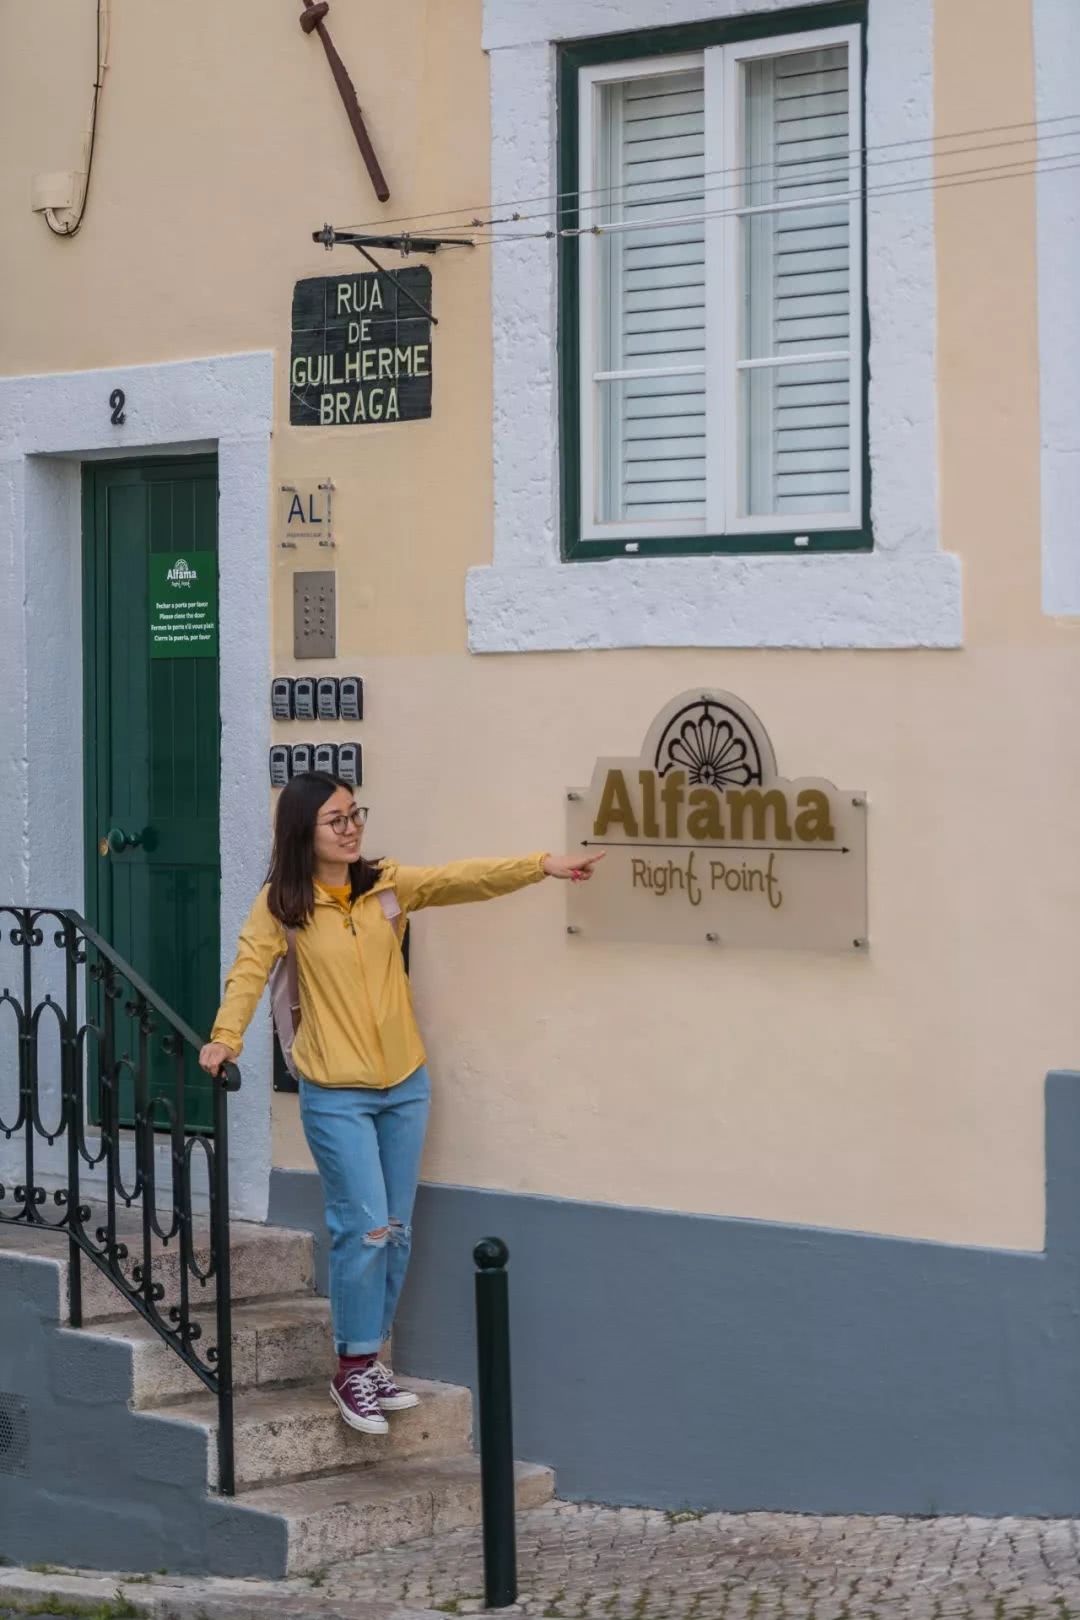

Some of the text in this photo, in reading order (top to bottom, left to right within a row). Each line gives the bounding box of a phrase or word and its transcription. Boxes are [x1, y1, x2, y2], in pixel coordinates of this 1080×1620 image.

[337, 278, 383, 315] RUA
[348, 319, 372, 344] DE
[292, 345, 429, 387] GUILHERME
[109, 388, 126, 425] 2
[320, 387, 400, 425] BRAGA
[287, 494, 322, 523] AL
[167, 569, 197, 580] Alfama
[592, 769, 835, 842] Alfama
[631, 850, 783, 909] Right Point
